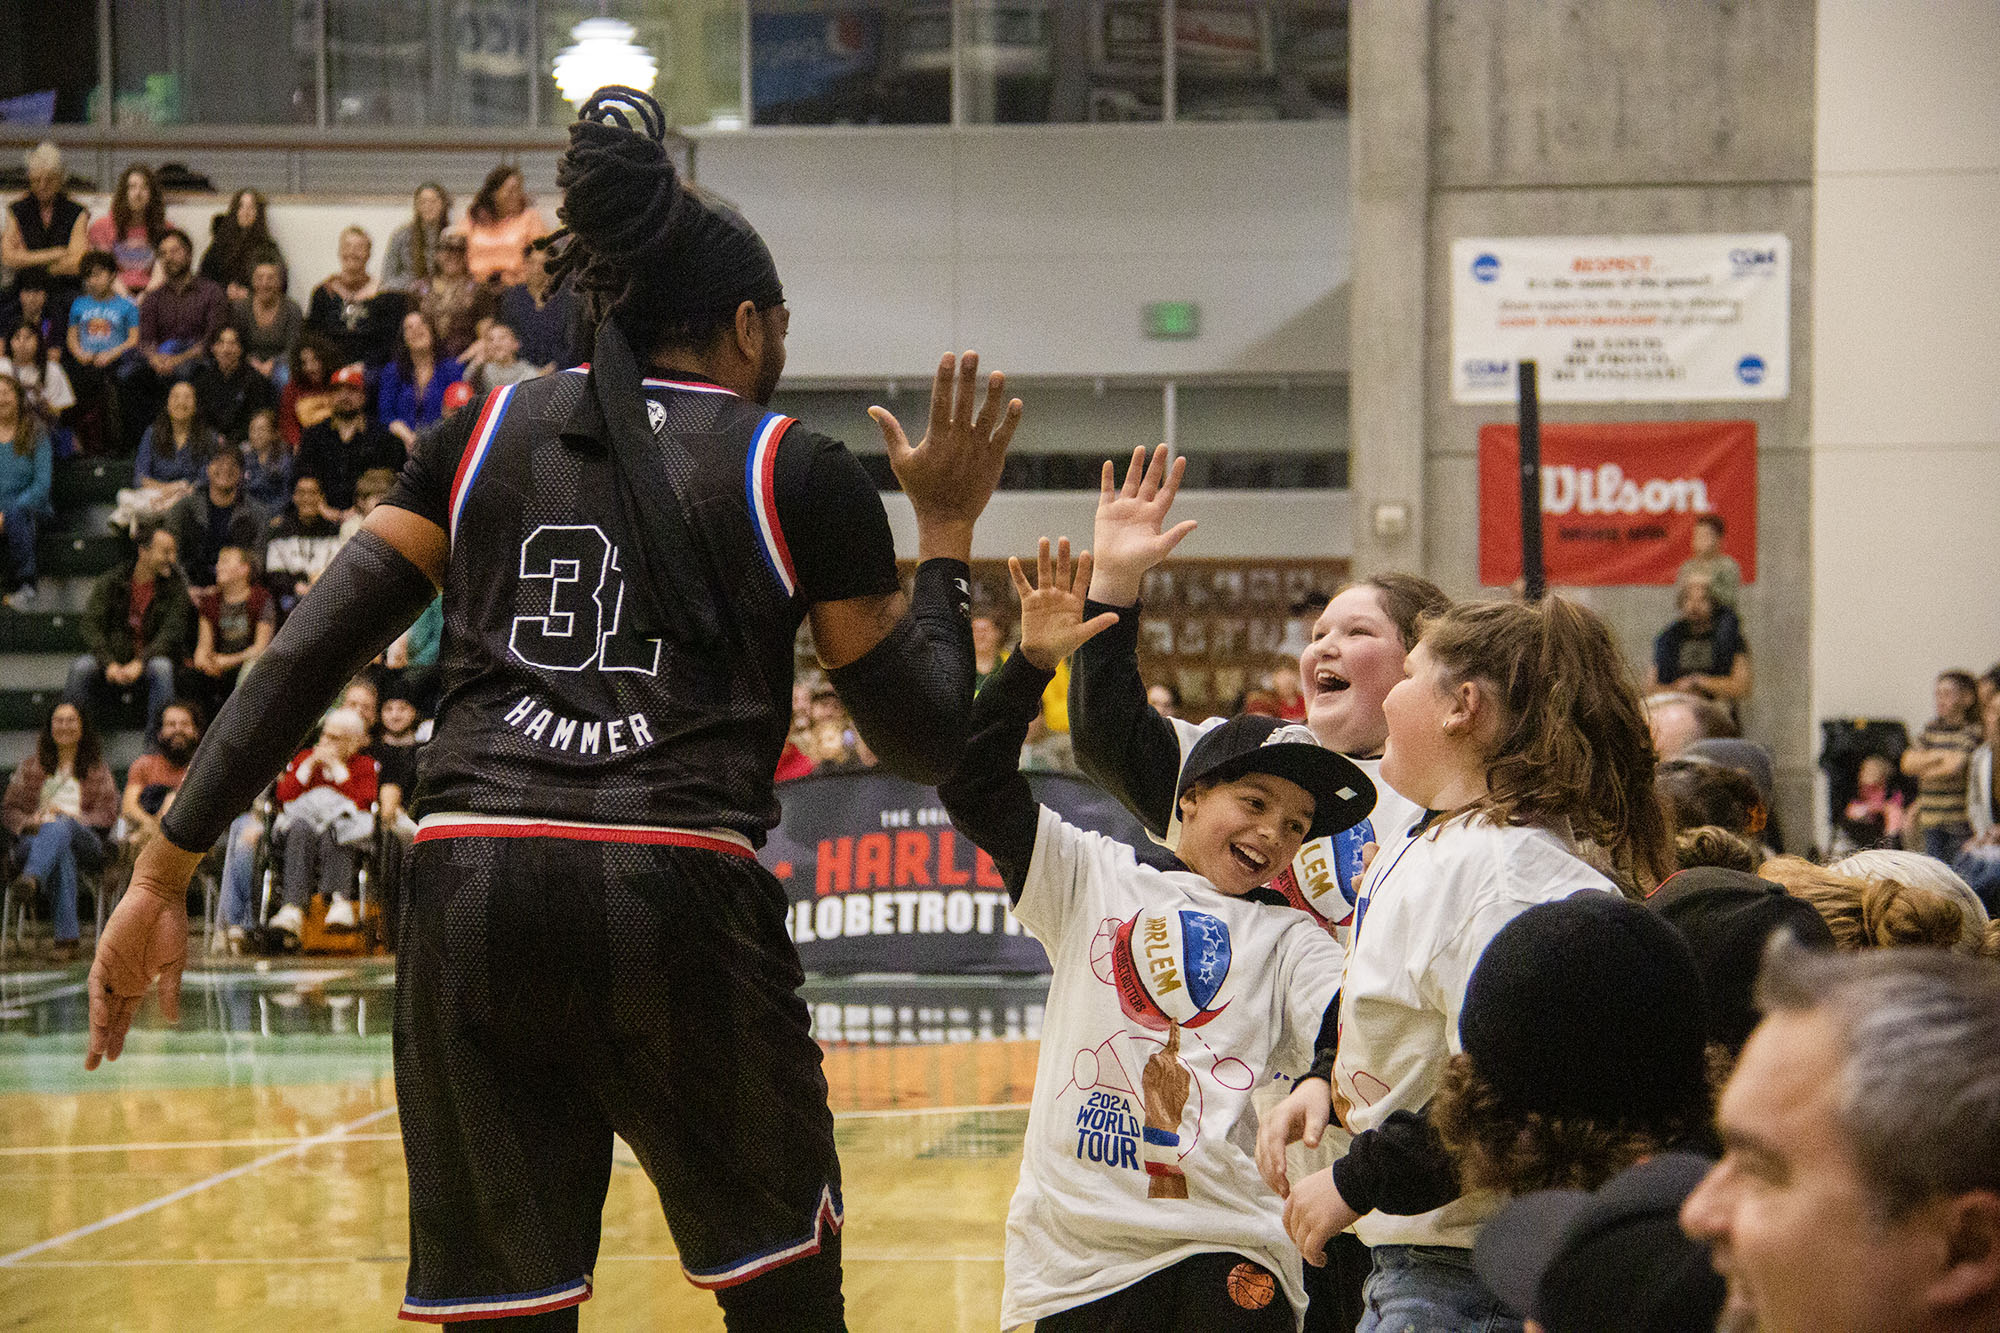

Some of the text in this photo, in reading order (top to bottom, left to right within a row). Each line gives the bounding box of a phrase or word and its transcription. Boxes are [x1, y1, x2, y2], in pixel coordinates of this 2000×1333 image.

[1541, 463, 1712, 515] Wilson
[503, 696, 653, 754] HAMMER
[815, 831, 1005, 896] HARLE
[1300, 842, 1335, 900] LEM
[785, 890, 1037, 944] LOBETROTT
[1076, 1105, 1141, 1138] WORLD
[1087, 1091, 1131, 1114] 2024
[1077, 1128, 1140, 1171] TOUR
